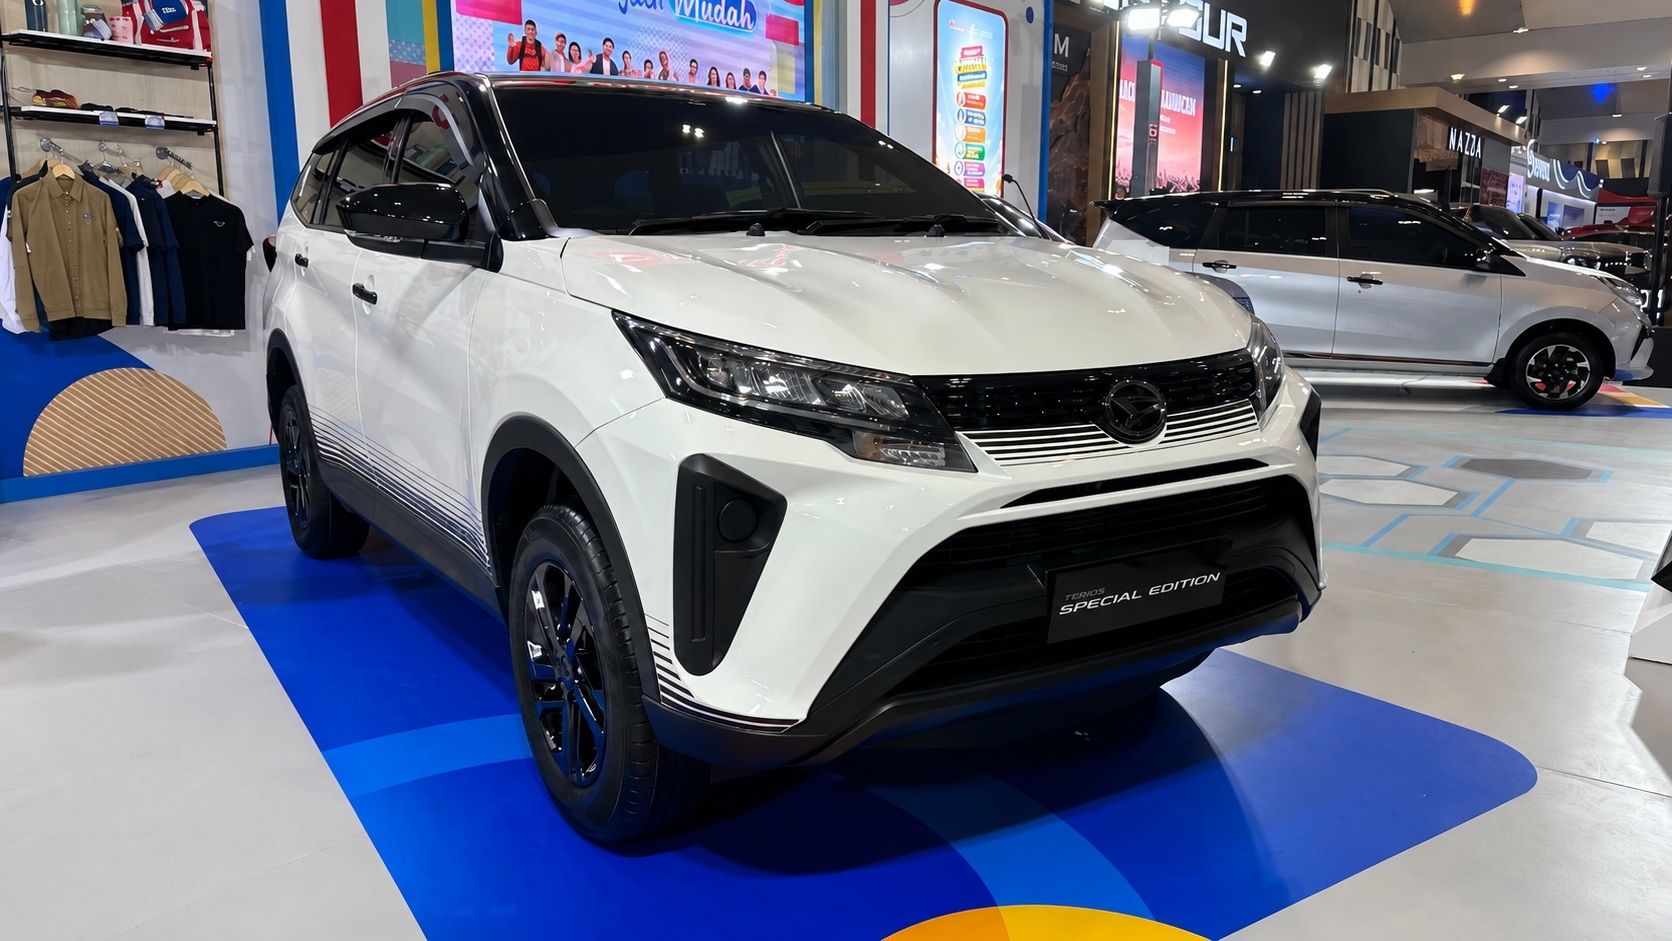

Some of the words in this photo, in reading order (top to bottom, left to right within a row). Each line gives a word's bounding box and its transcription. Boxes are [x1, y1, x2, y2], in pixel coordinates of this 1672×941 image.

[1059, 590, 1142, 615] SPECIAL
[1148, 572, 1221, 596] EDITION
[1065, 587, 1106, 601] TERIOS
